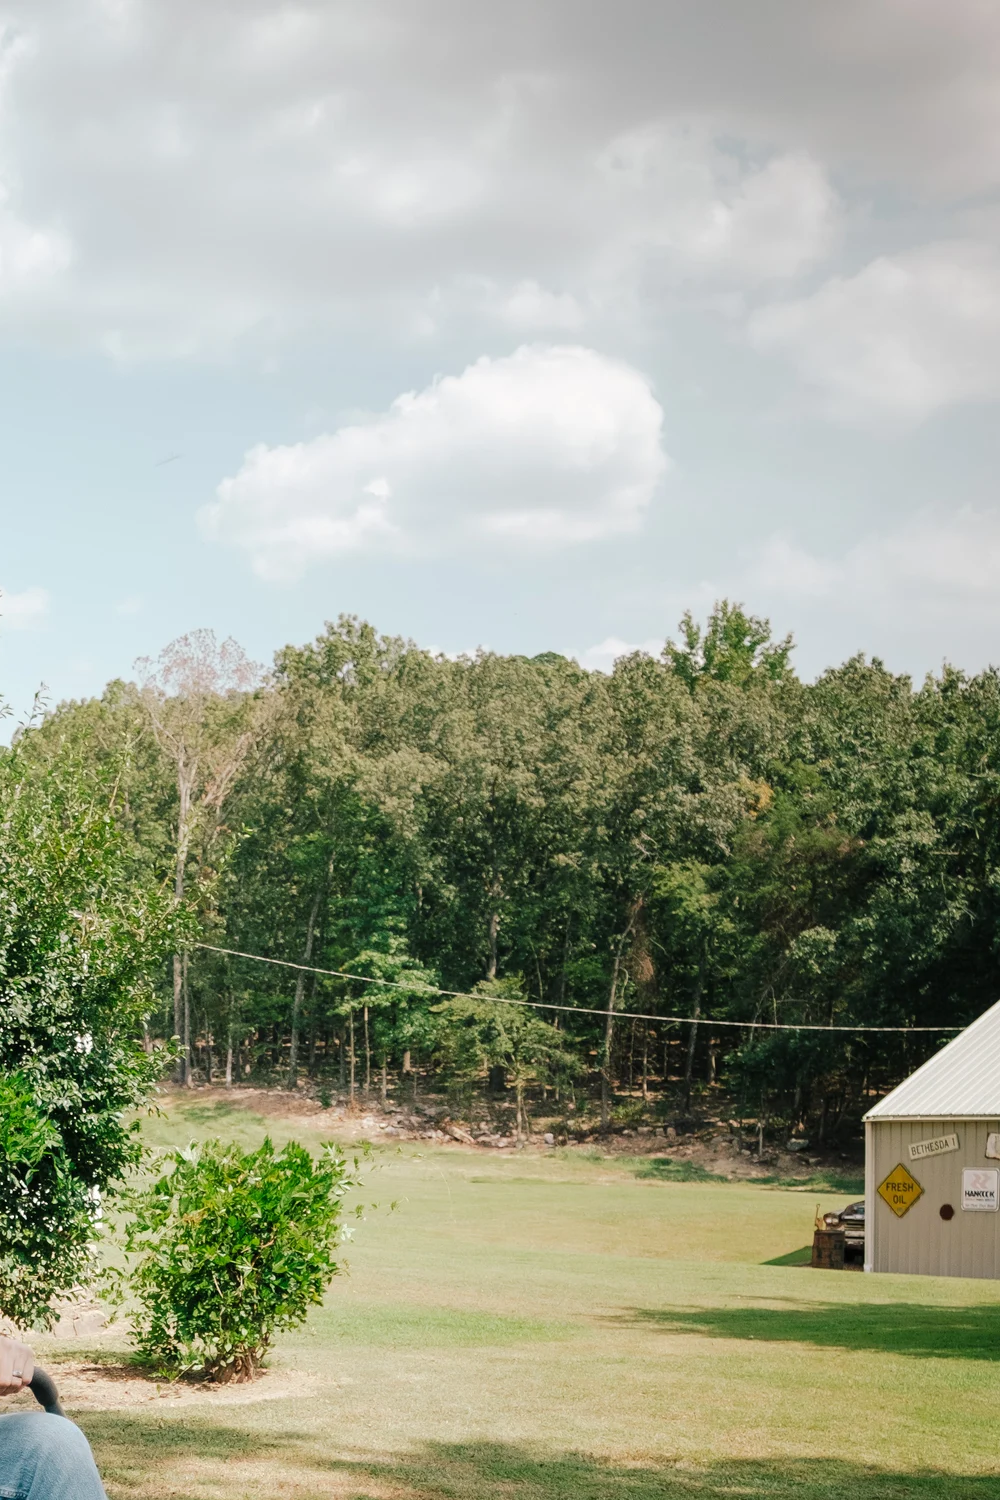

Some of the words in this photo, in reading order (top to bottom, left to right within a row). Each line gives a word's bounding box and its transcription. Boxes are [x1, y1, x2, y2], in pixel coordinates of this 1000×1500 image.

[911, 1139, 949, 1156] BETHESDA
[886, 1182, 914, 1192] FRESH
[893, 1194, 906, 1204] OIL
